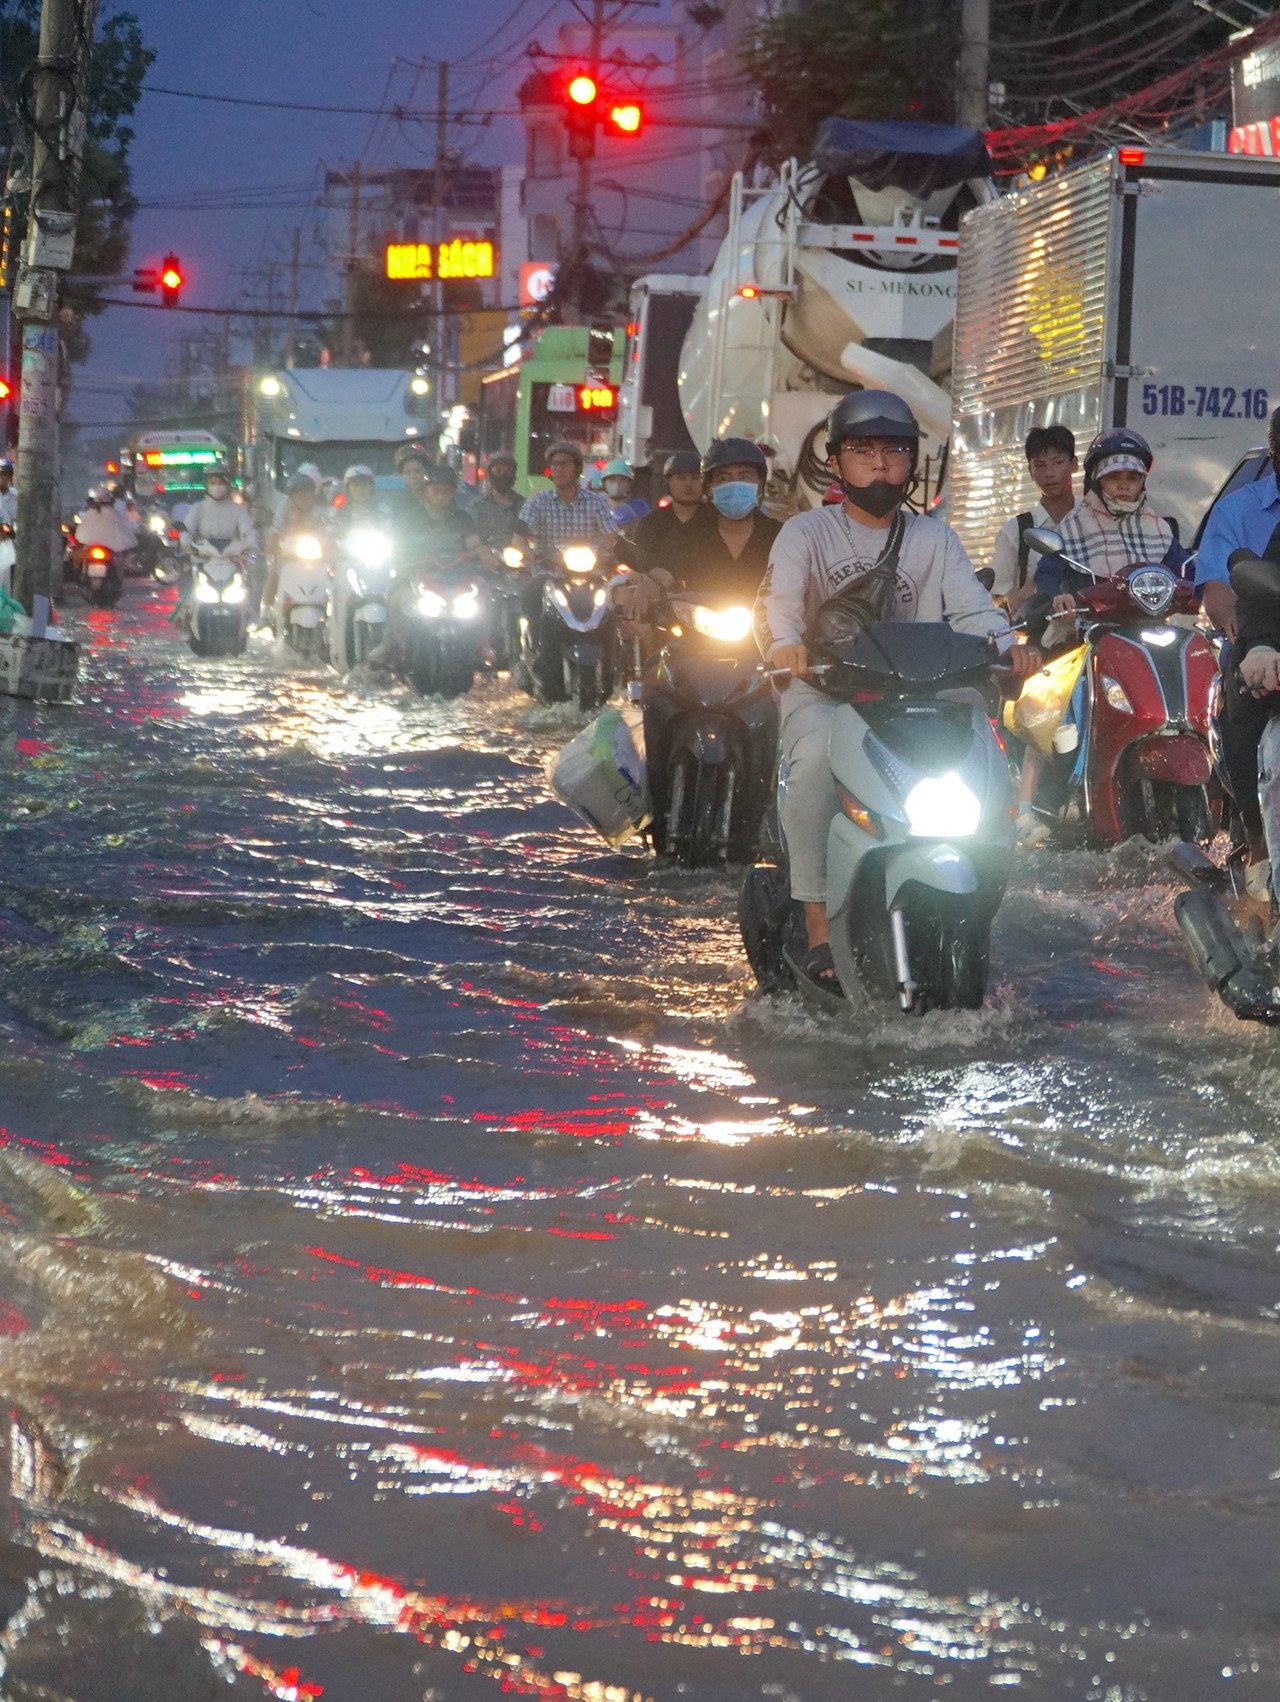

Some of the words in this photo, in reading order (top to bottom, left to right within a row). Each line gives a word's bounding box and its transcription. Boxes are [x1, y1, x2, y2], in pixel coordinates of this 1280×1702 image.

[438, 239, 493, 279] SÁCH
[880, 281, 957, 299] MEKONG
[1143, 384, 1268, 419] 51B-742.16
